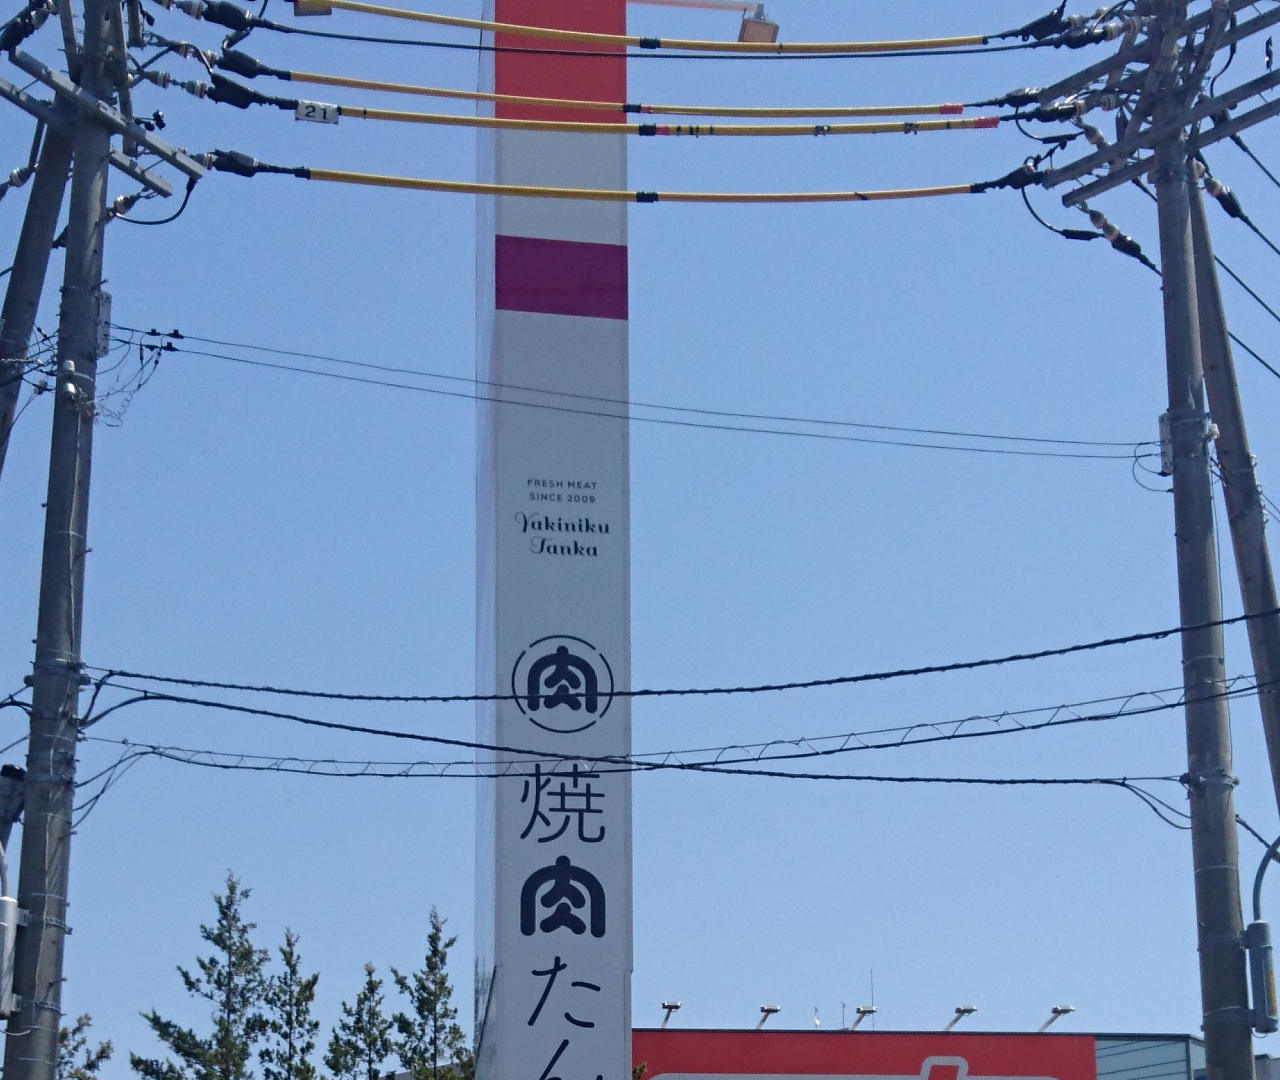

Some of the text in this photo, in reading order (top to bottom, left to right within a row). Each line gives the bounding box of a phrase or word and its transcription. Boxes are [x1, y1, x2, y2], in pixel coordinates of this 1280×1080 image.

[305, 105, 327, 120] 21
[527, 479, 598, 490] FRESH MEAT
[529, 492, 596, 503] SINCE 2009
[514, 511, 610, 534] Yakiniku
[530, 536, 598, 557] Tanka
